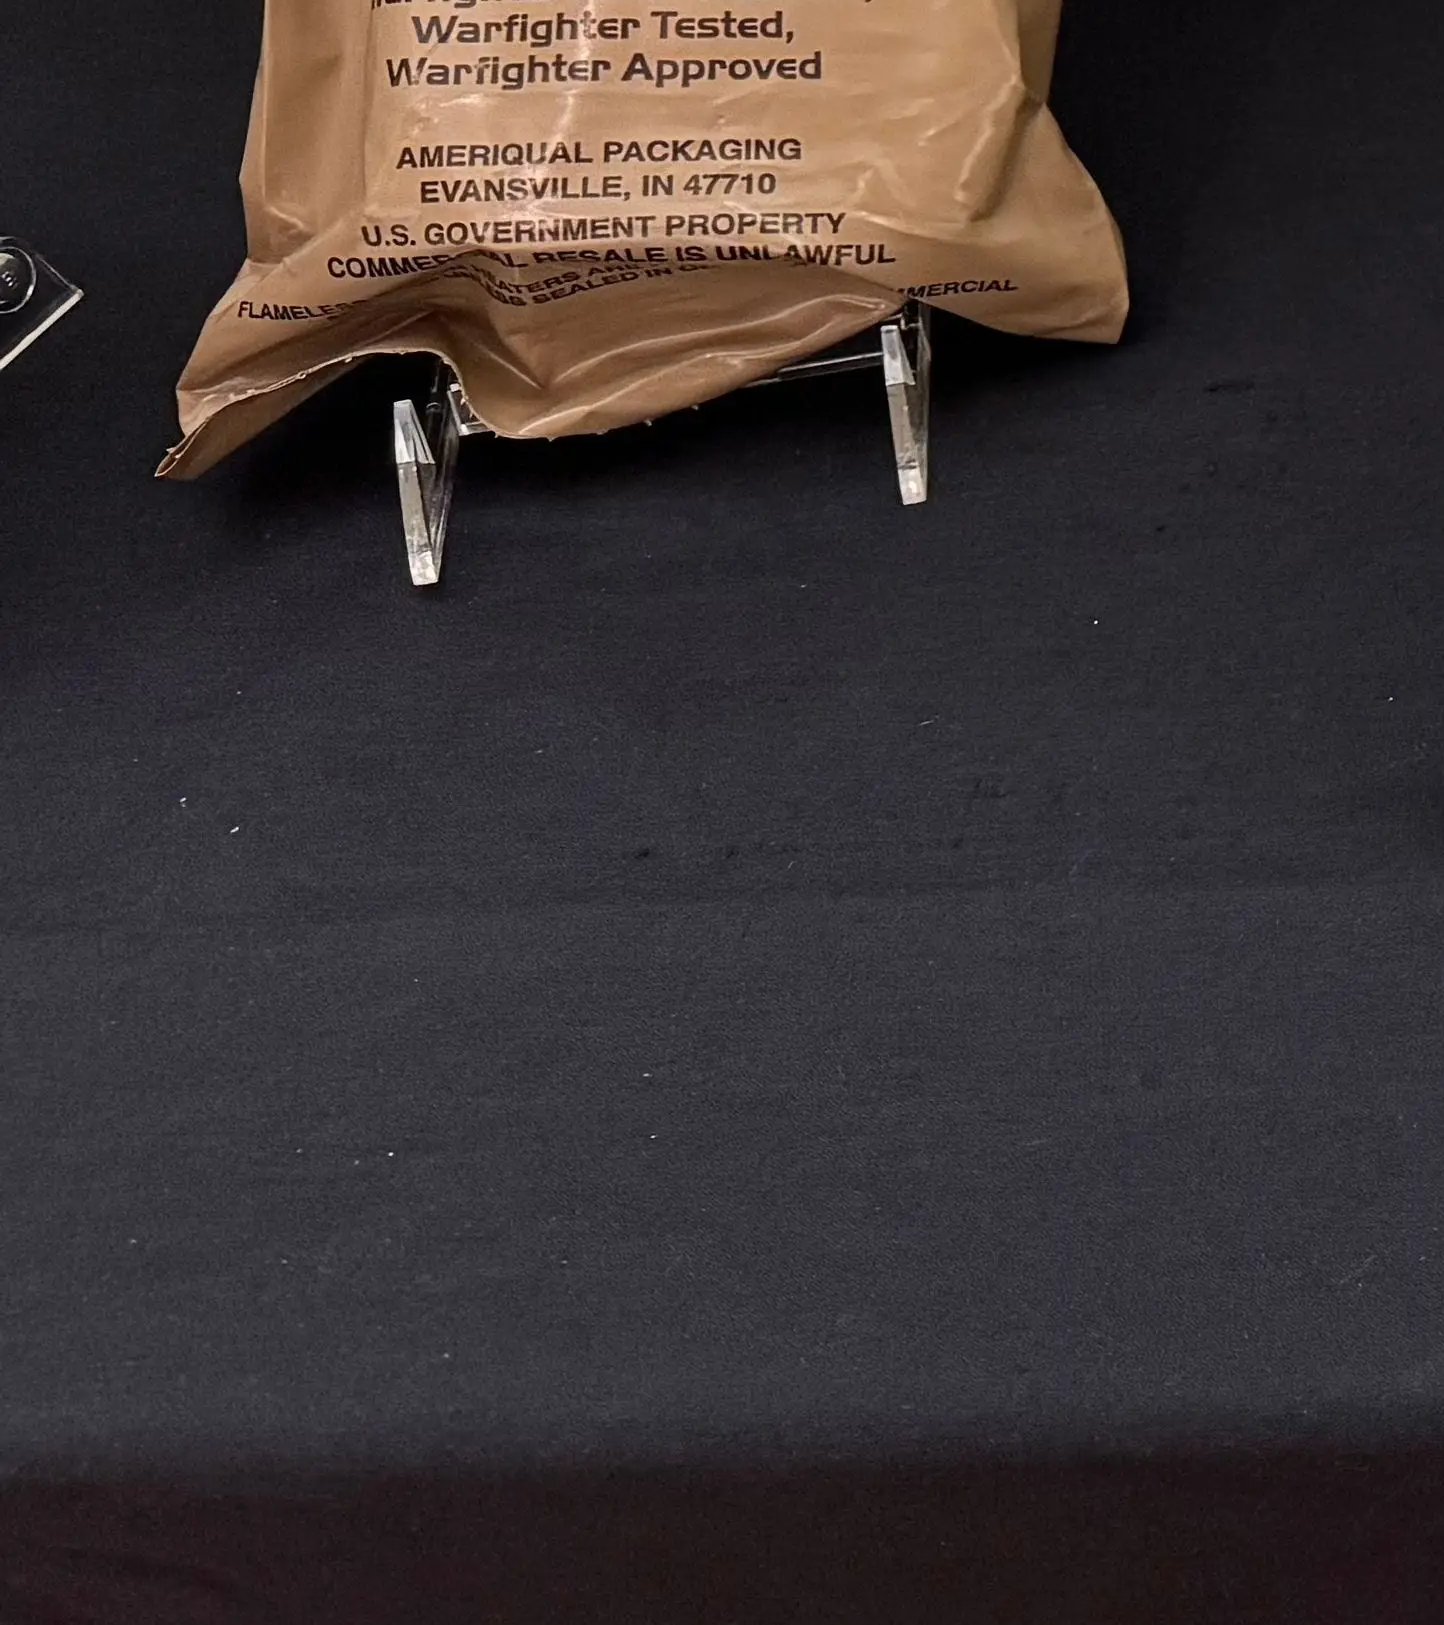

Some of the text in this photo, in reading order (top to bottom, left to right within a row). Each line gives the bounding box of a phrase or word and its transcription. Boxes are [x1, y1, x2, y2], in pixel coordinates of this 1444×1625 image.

[411, 9, 795, 48] Warfighter Tested,
[386, 50, 823, 91] Warfighter Approved
[396, 137, 802, 170] AMERIQUAL PACKAGING
[419, 171, 777, 205] EVANSVILLE, IN 47710
[360, 211, 847, 248] U.S. GOVERNMENT PROPERTY
[532, 242, 897, 268] RESALE IS UNLAWFUL
